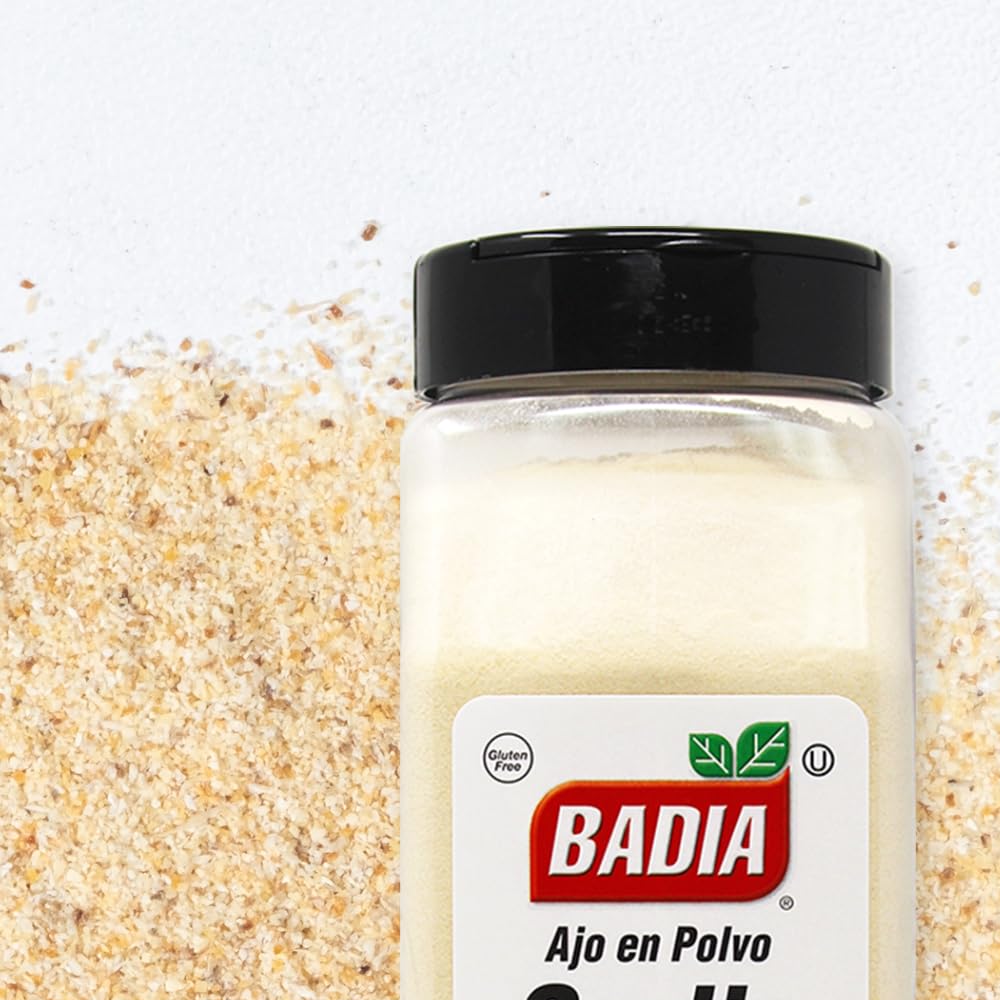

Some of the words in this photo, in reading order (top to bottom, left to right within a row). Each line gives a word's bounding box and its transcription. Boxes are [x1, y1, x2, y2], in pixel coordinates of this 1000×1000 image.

[488, 749, 528, 761] Gluten
[494, 760, 522, 772] Free
[547, 804, 768, 877] BADIA
[544, 926, 606, 971] Ajo
[616, 934, 661, 963] en
[671, 926, 772, 963] Polvo
